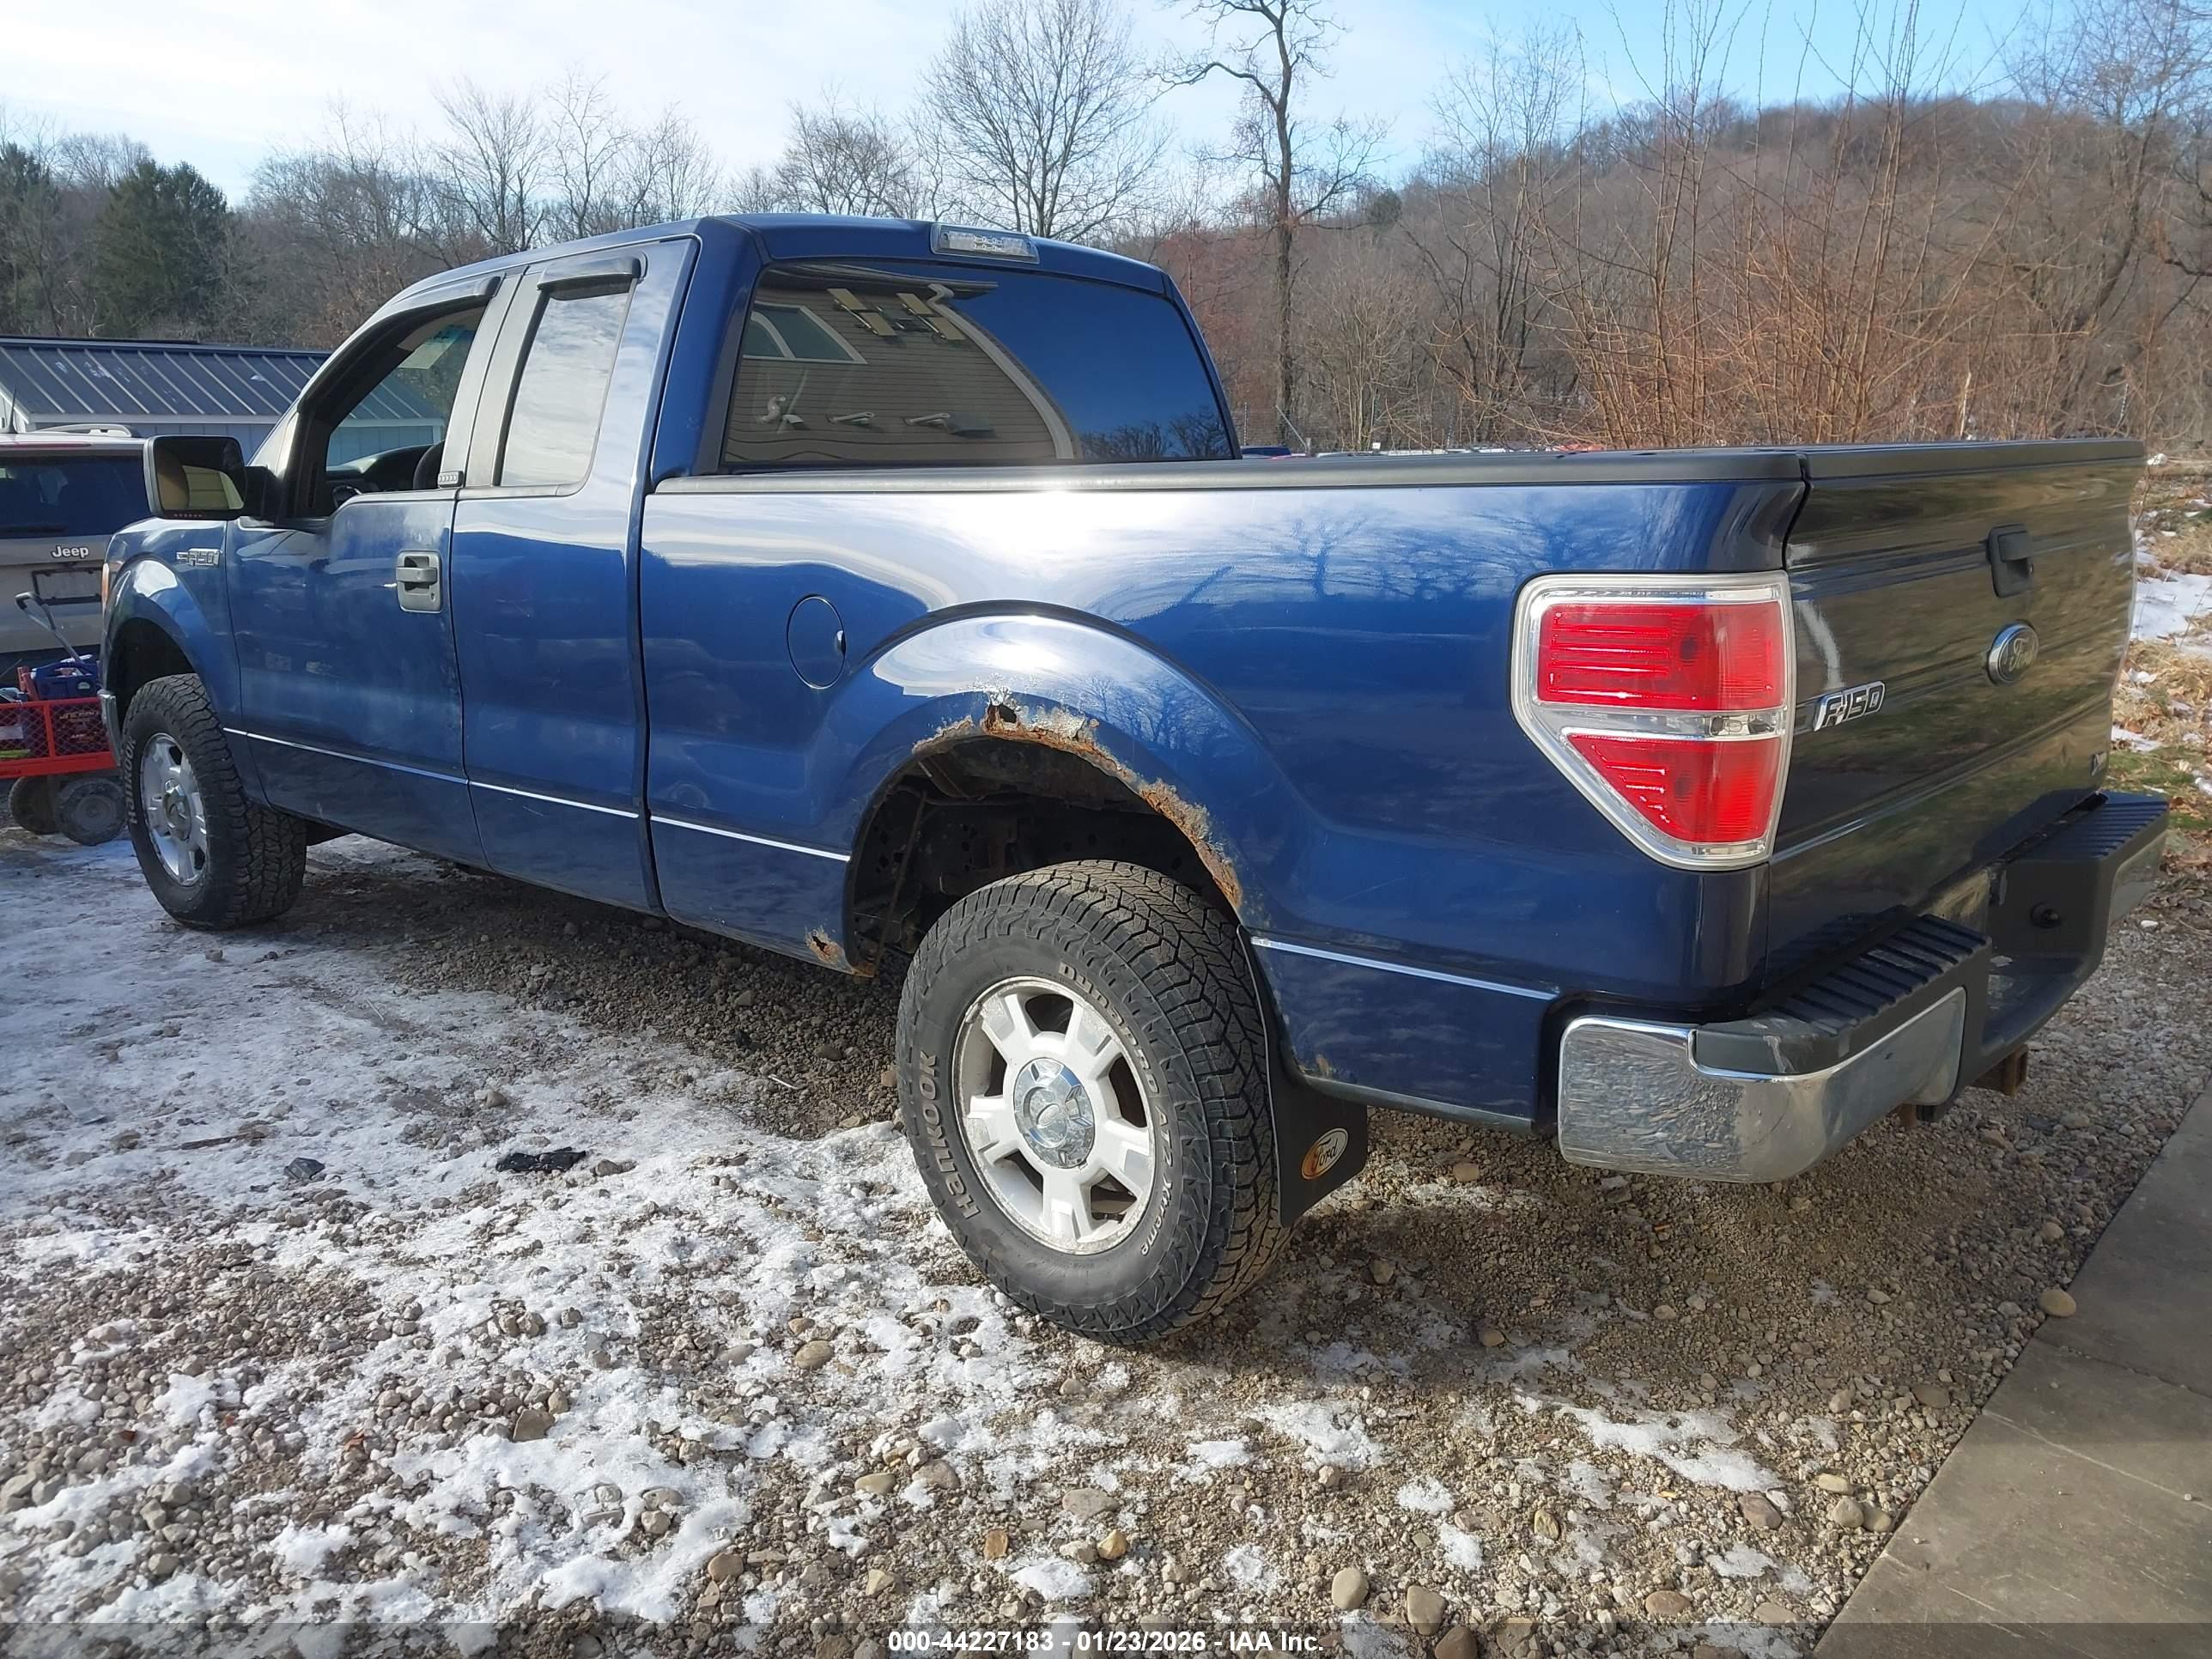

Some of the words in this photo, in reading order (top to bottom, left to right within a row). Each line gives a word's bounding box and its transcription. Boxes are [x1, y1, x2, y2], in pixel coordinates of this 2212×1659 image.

[52, 545, 89, 558] Jeep
[1155, 1104, 1173, 1168] AT2
[1310, 1137, 1339, 1172] Ford
[1139, 1173, 1174, 1256] Xtreme
